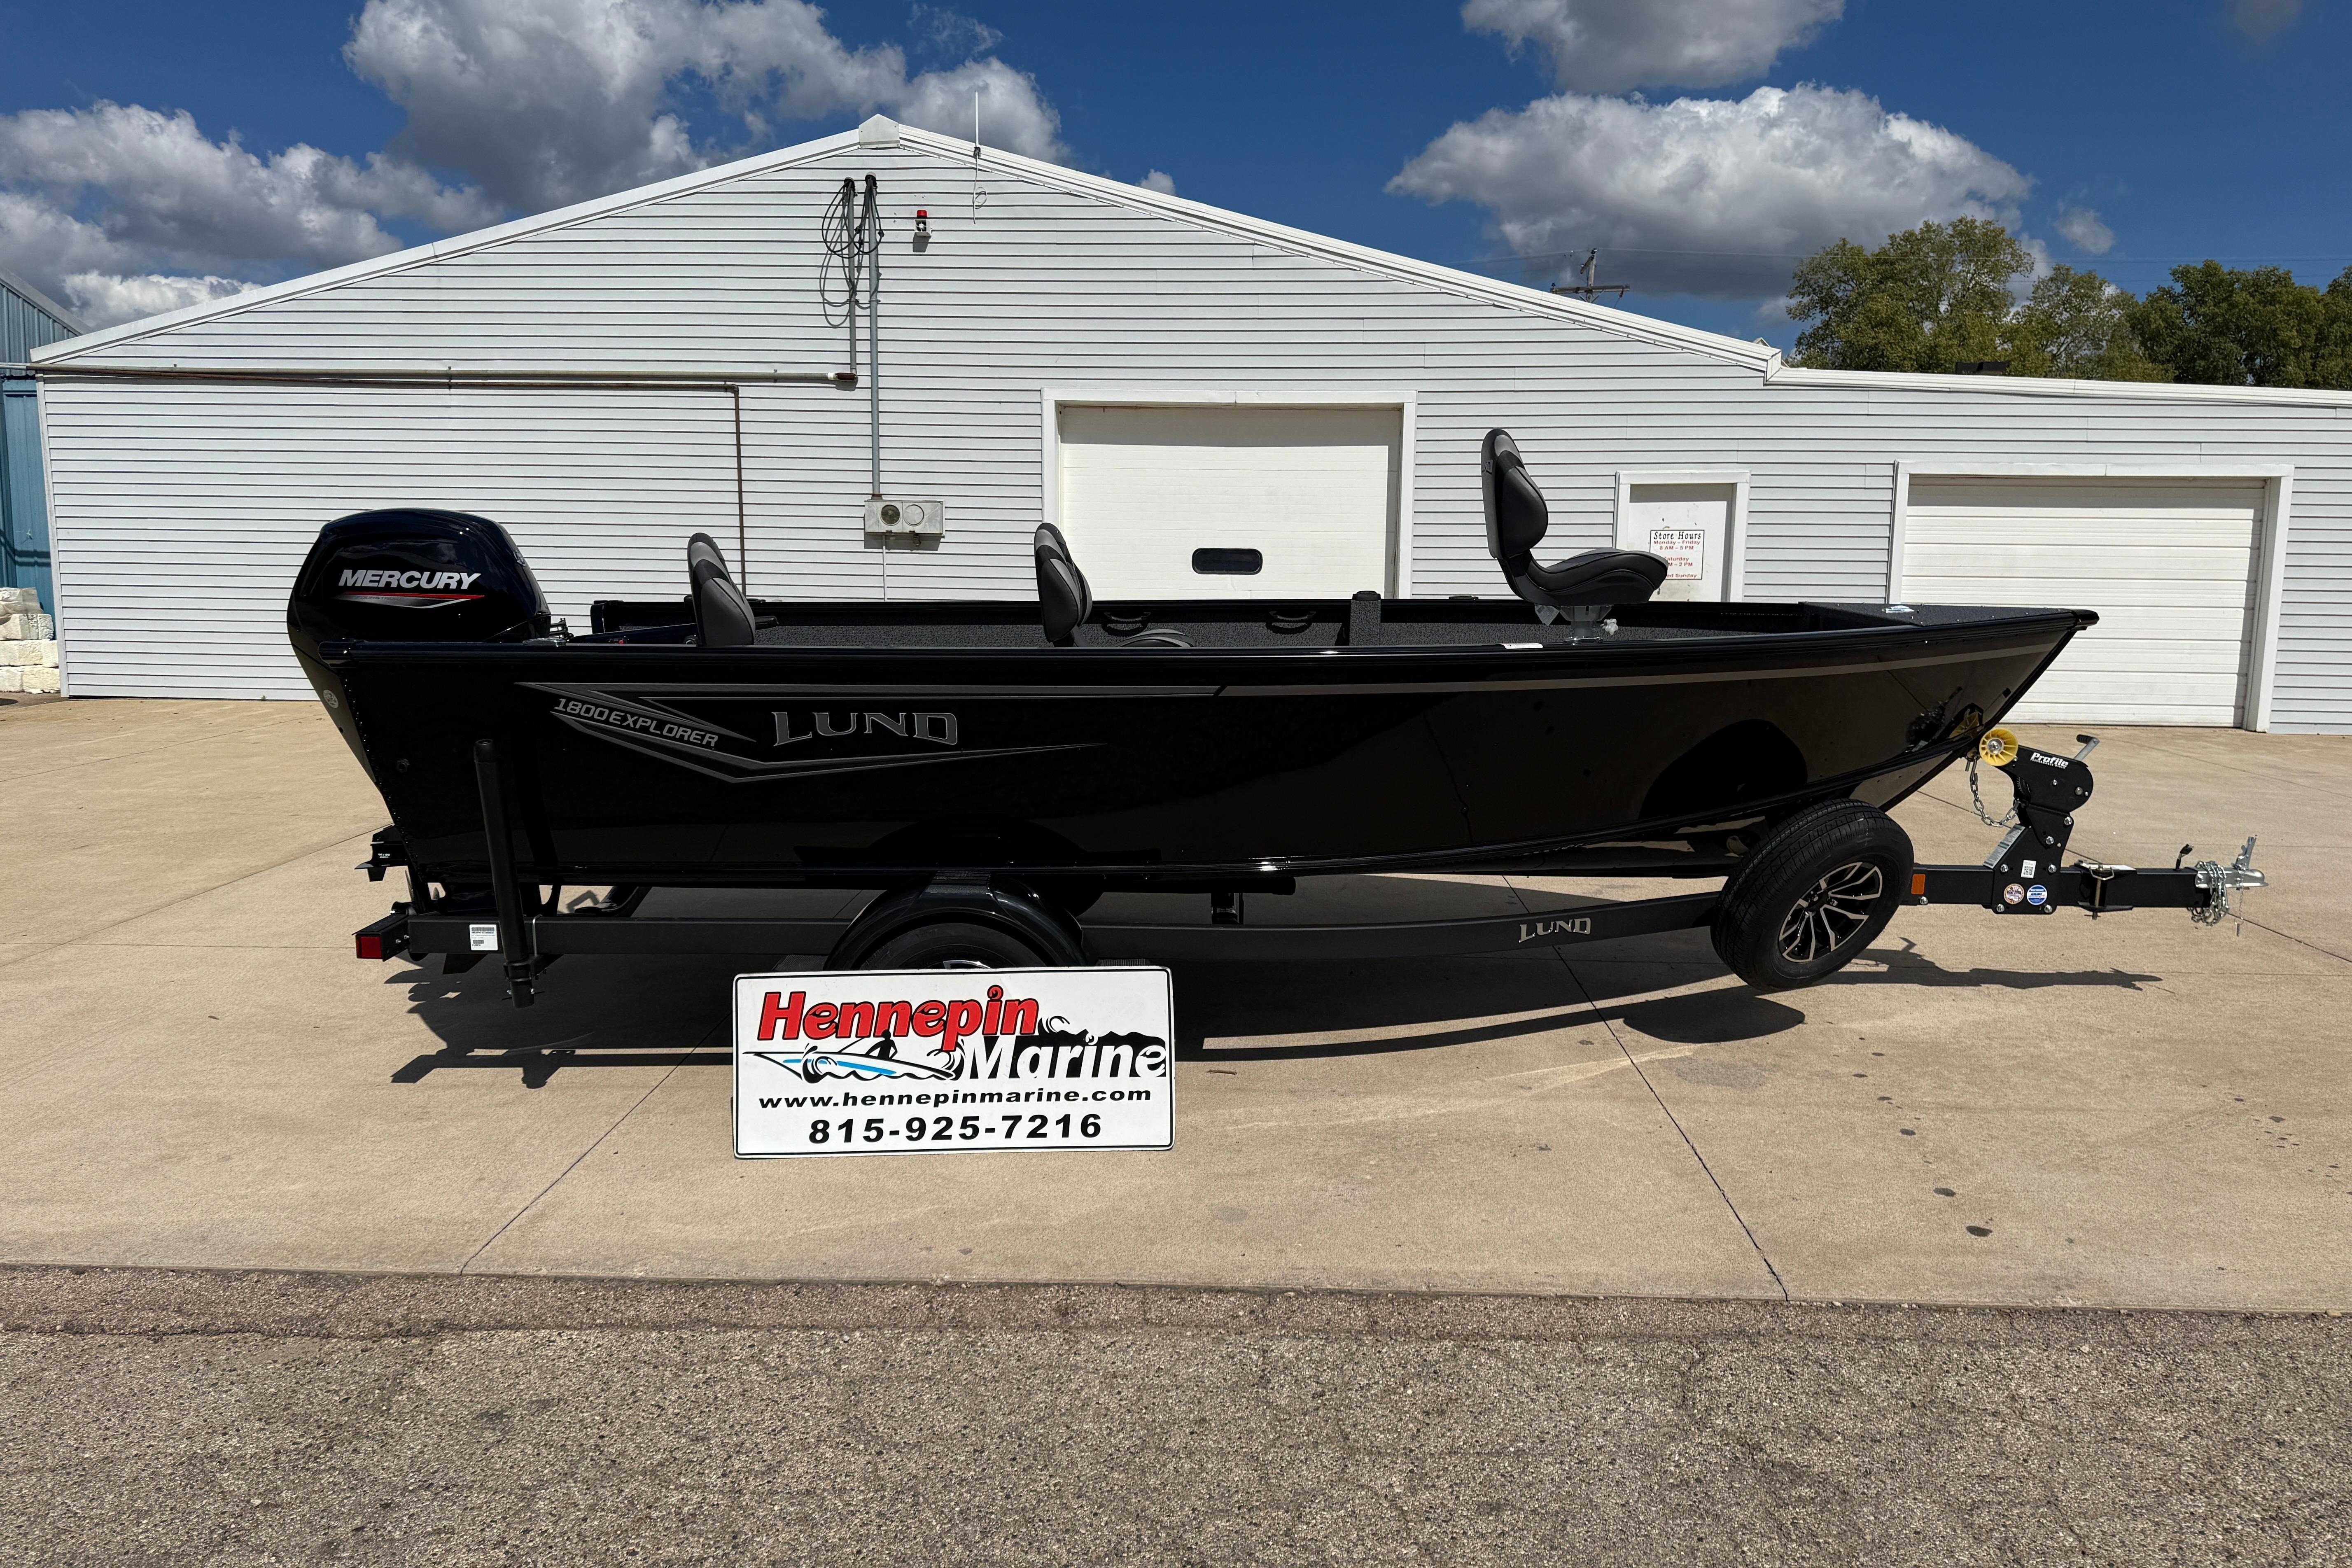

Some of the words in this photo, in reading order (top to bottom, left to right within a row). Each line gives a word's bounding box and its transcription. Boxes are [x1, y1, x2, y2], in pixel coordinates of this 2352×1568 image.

[1653, 531, 1674, 540] Store
[1678, 531, 1701, 540] Hours
[338, 569, 481, 590] MERCURY
[553, 698, 609, 721] 1800
[609, 711, 719, 747] EXPLORER
[771, 712, 958, 747] LUND
[2031, 752, 2069, 768] Profile
[1518, 917, 1591, 943] LUND
[756, 985, 1039, 1052] Hennepin
[964, 1030, 1167, 1079] Marine
[758, 1088, 1151, 1108] www.hennepinmarine.com
[808, 1113, 1101, 1144] 815-925-7216
